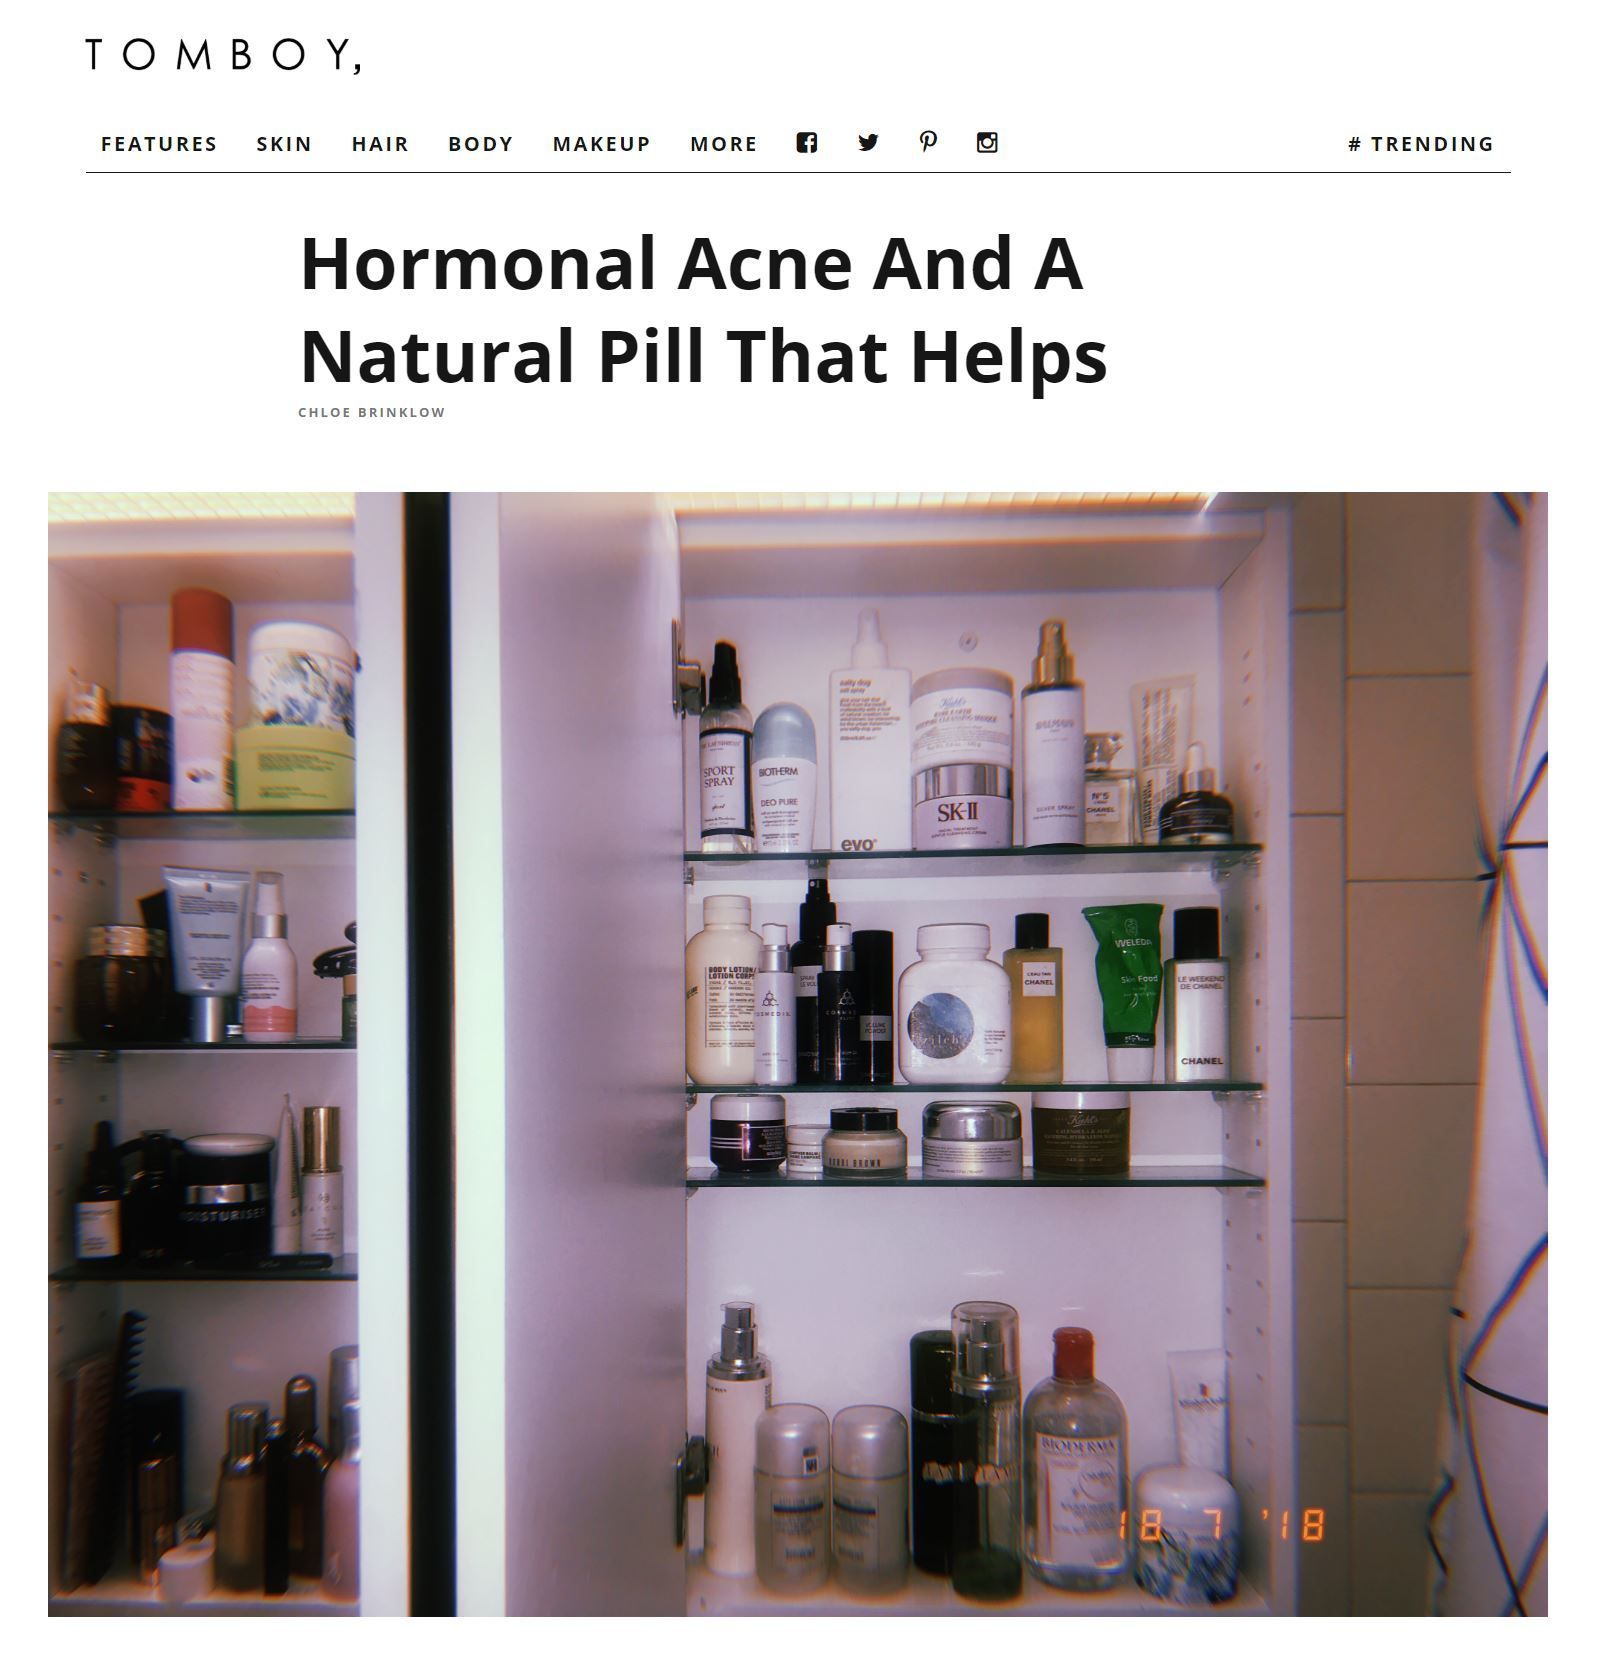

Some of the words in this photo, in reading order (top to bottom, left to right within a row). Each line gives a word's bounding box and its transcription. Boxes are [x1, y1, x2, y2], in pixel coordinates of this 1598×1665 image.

[85, 38, 362, 75] TOMBOY,
[101, 136, 217, 152] FEATURES
[256, 136, 312, 152] SKIN
[352, 136, 409, 152] HAIR
[449, 136, 513, 152] BODY
[553, 136, 651, 152] MAKEUP
[691, 136, 757, 152] MORE
[1372, 136, 1494, 152] TRENDING
[303, 233, 654, 291] Hormonal
[677, 237, 852, 291] Acne
[873, 233, 1011, 291] And
[1034, 237, 1084, 290] A
[303, 326, 572, 384] Natural
[601, 326, 702, 383] Pill
[727, 326, 888, 384] That
[913, 326, 1107, 400] Helps
[298, 407, 351, 418] CHLOE
[358, 407, 445, 418] BRINKLOW
[704, 766, 735, 777] SPORT
[759, 766, 799, 777] BIOTHERM
[704, 777, 735, 789] SPRAY
[761, 799, 777, 807] DEO
[778, 798, 799, 806] PURE
[1115, 938, 1152, 948] WELEDA
[1137, 975, 1158, 983] Food
[1180, 1057, 1225, 1065] CHANEL
[852, 1159, 881, 1168] BROWN
[178, 1206, 266, 1222] OISTURISER
